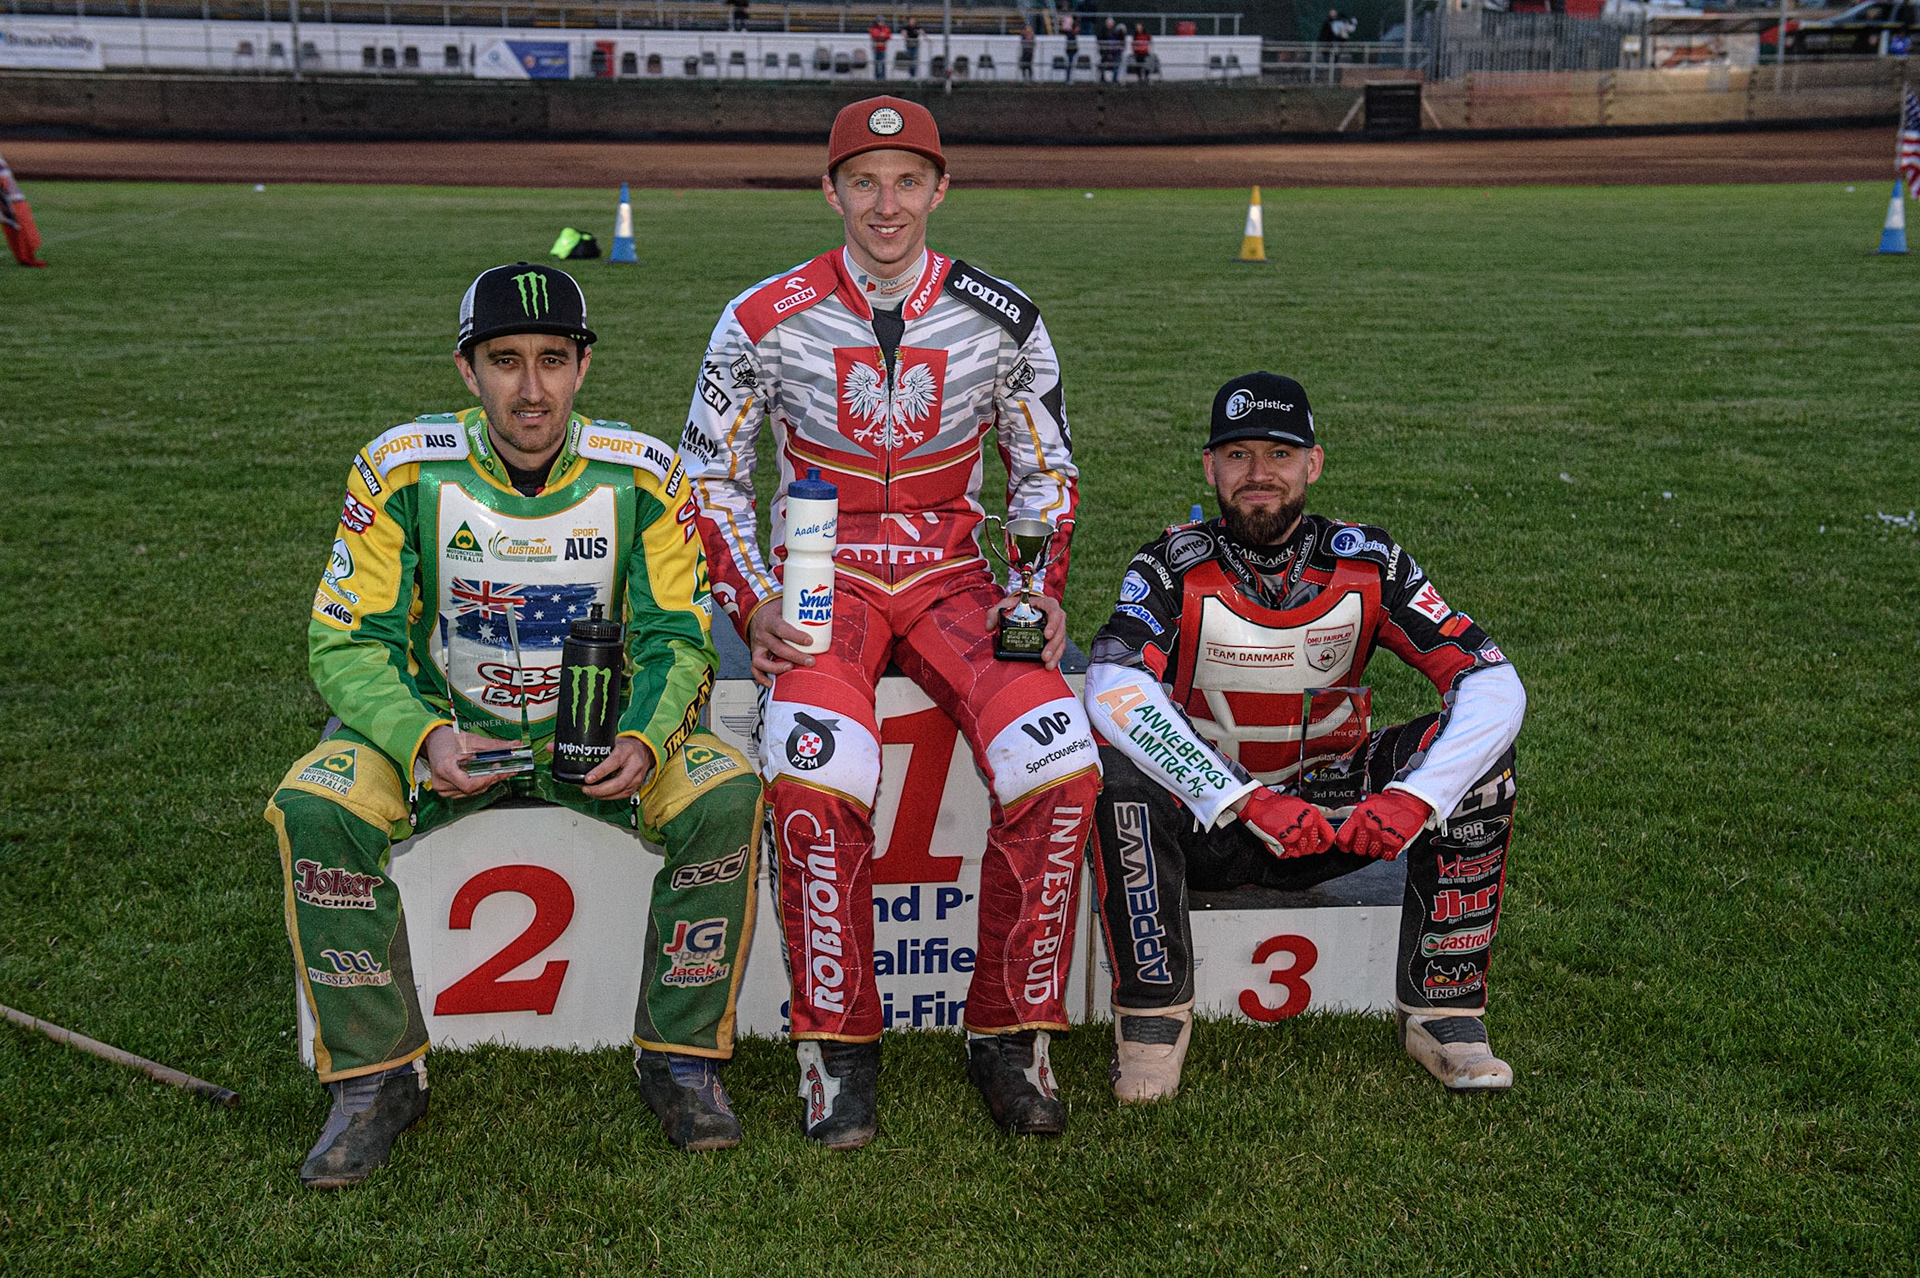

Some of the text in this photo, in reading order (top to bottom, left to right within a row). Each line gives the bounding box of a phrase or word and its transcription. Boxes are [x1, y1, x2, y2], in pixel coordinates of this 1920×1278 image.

[777, 290, 814, 310] ORLEN
[572, 528, 599, 537] SPORT
[446, 548, 484, 557] MOTORCYCLING
[446, 553, 484, 563] AUSTRALIA
[506, 546, 552, 554] AUSTRALIA
[565, 537, 608, 560] AUS
[1172, 539, 1207, 561] GANTECH
[799, 587, 832, 608] Smak
[1323, 632, 1352, 642] FAIRPLAY
[1206, 648, 1295, 662] TEAM DANMARK
[1025, 739, 1093, 774] SportoweFakty
[1134, 705, 1232, 790] ANNEBERGS
[791, 755, 819, 769] PZM
[303, 768, 353, 788] MOTORCYCLING
[693, 761, 738, 785] AUSTRALIA
[297, 774, 348, 795] AUSTRALIA
[1452, 822, 1485, 839] BAR
[295, 860, 383, 897] Joker
[299, 893, 376, 908] MACHINE
[1024, 806, 1083, 1005] INVEST-BUD
[1431, 884, 1498, 921] jhr
[433, 864, 575, 1016] 2
[666, 921, 725, 953] JG
[1440, 929, 1489, 950] Castrol
[674, 946, 723, 963] sport
[664, 967, 727, 984] Gajewski
[671, 964, 716, 977] Jacek
[1238, 934, 1319, 1023] 3
